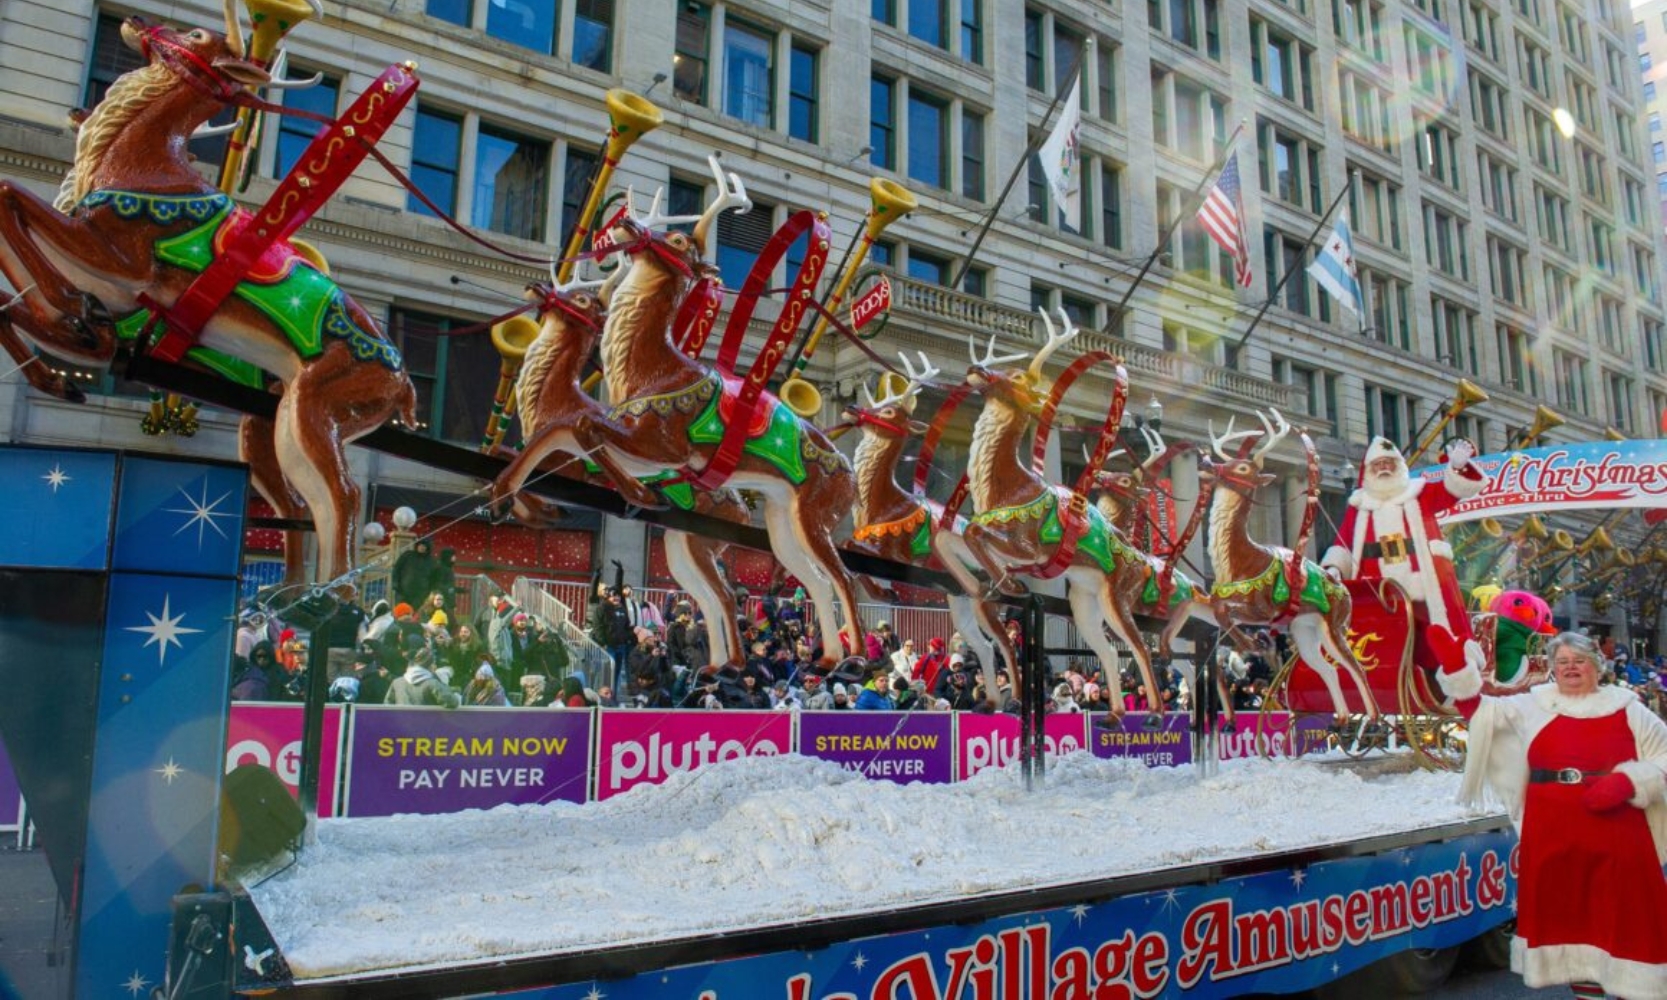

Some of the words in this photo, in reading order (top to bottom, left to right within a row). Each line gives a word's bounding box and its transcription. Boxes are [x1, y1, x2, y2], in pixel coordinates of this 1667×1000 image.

[1518, 450, 1667, 496] Christmas
[1454, 496, 1506, 512] Drive
[1520, 492, 1565, 501] Thru
[377, 737, 494, 757] STREAM
[502, 737, 568, 756] NOW
[816, 735, 892, 752] STREAM
[895, 735, 938, 750] NOW
[1101, 733, 1151, 747] STREAM
[1153, 732, 1182, 745] NOW
[1205, 727, 1270, 759] luto
[966, 729, 1057, 777] pluo
[869, 759, 925, 776] NEVER
[399, 769, 451, 789] PAY
[459, 768, 544, 788] NEVER
[872, 922, 1170, 1000] Village
[1176, 851, 1473, 989] Amusement
[1476, 849, 1507, 910] &
